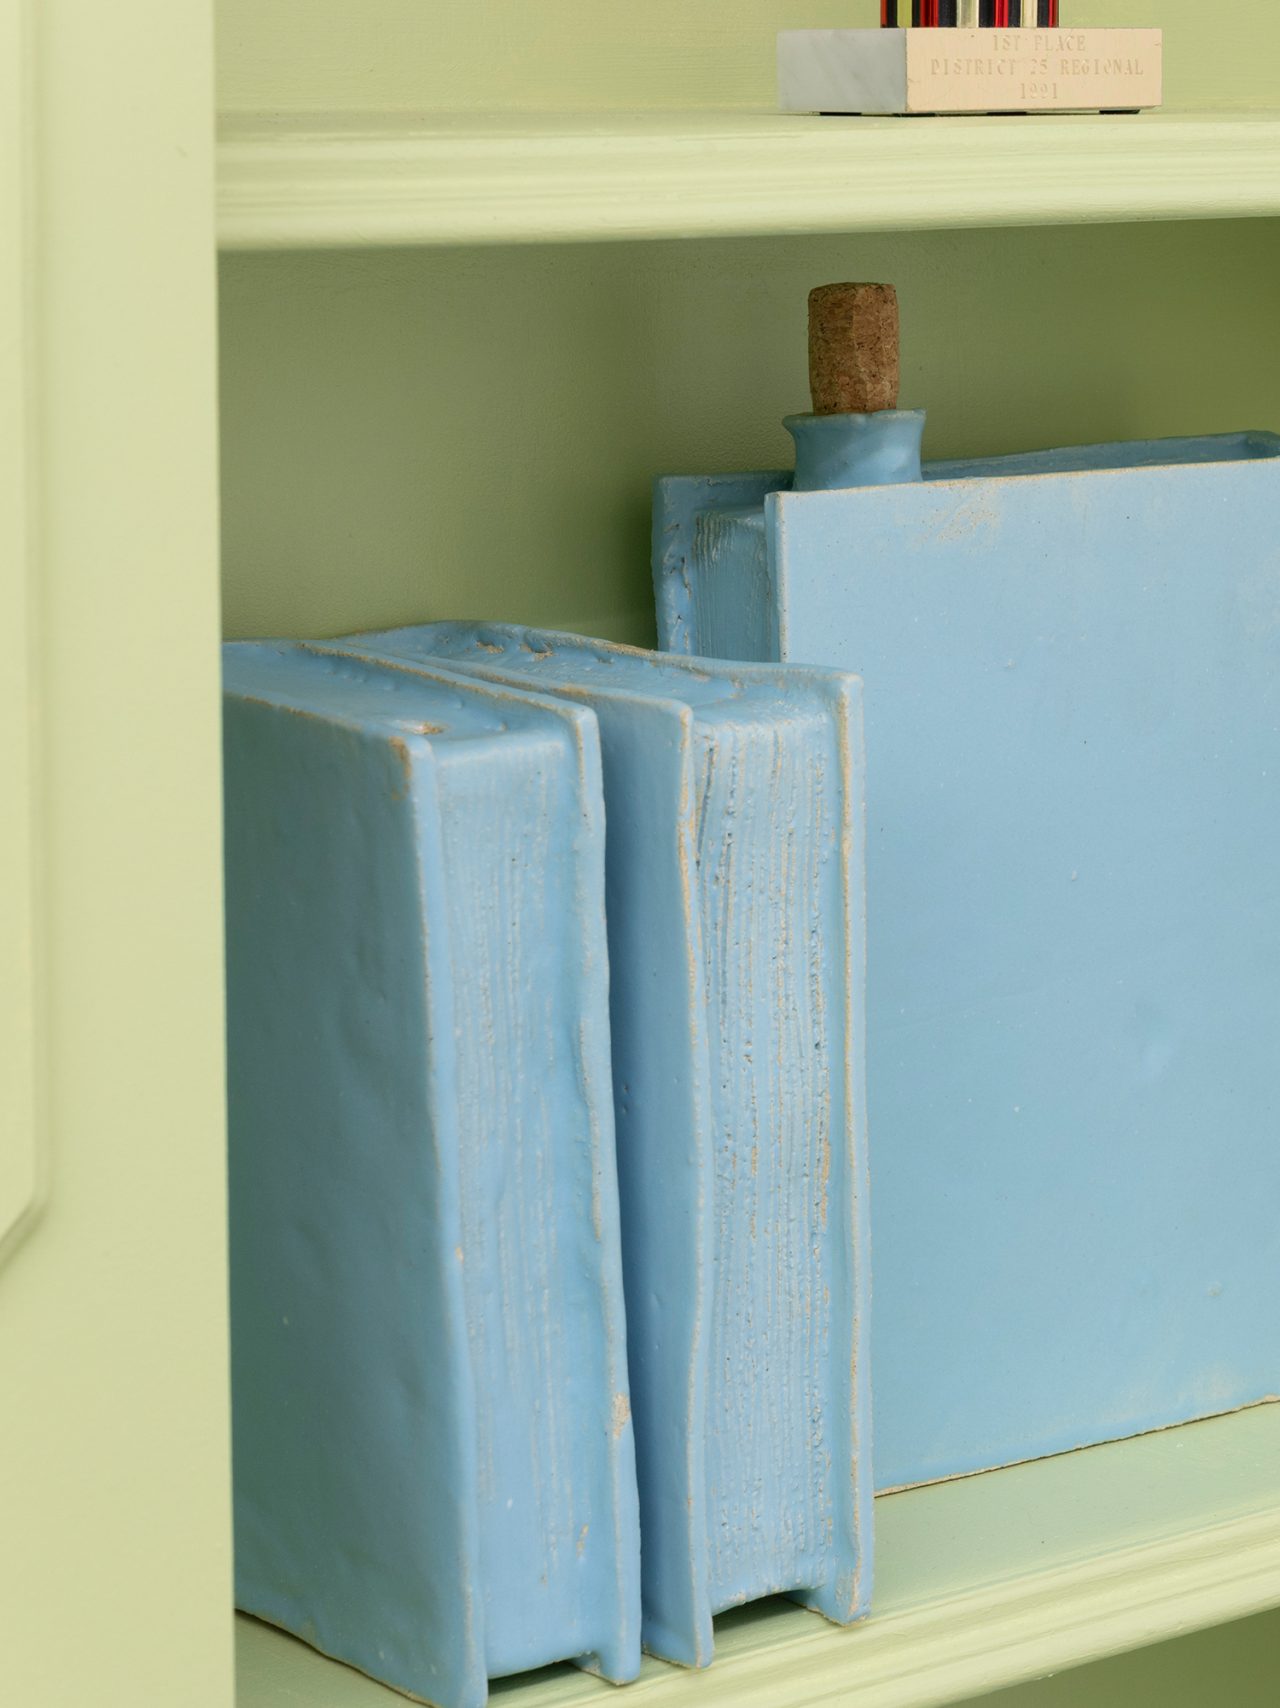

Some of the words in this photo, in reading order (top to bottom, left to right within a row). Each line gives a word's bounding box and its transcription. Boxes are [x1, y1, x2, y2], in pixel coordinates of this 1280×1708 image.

[993, 34, 1021, 51] 1ST
[1034, 34, 1086, 51] PLACE
[930, 59, 1017, 75] DISTRICT
[1030, 58, 1048, 75] 25
[1060, 58, 1144, 75] REGIONAL
[1020, 82, 1058, 99] 1991
